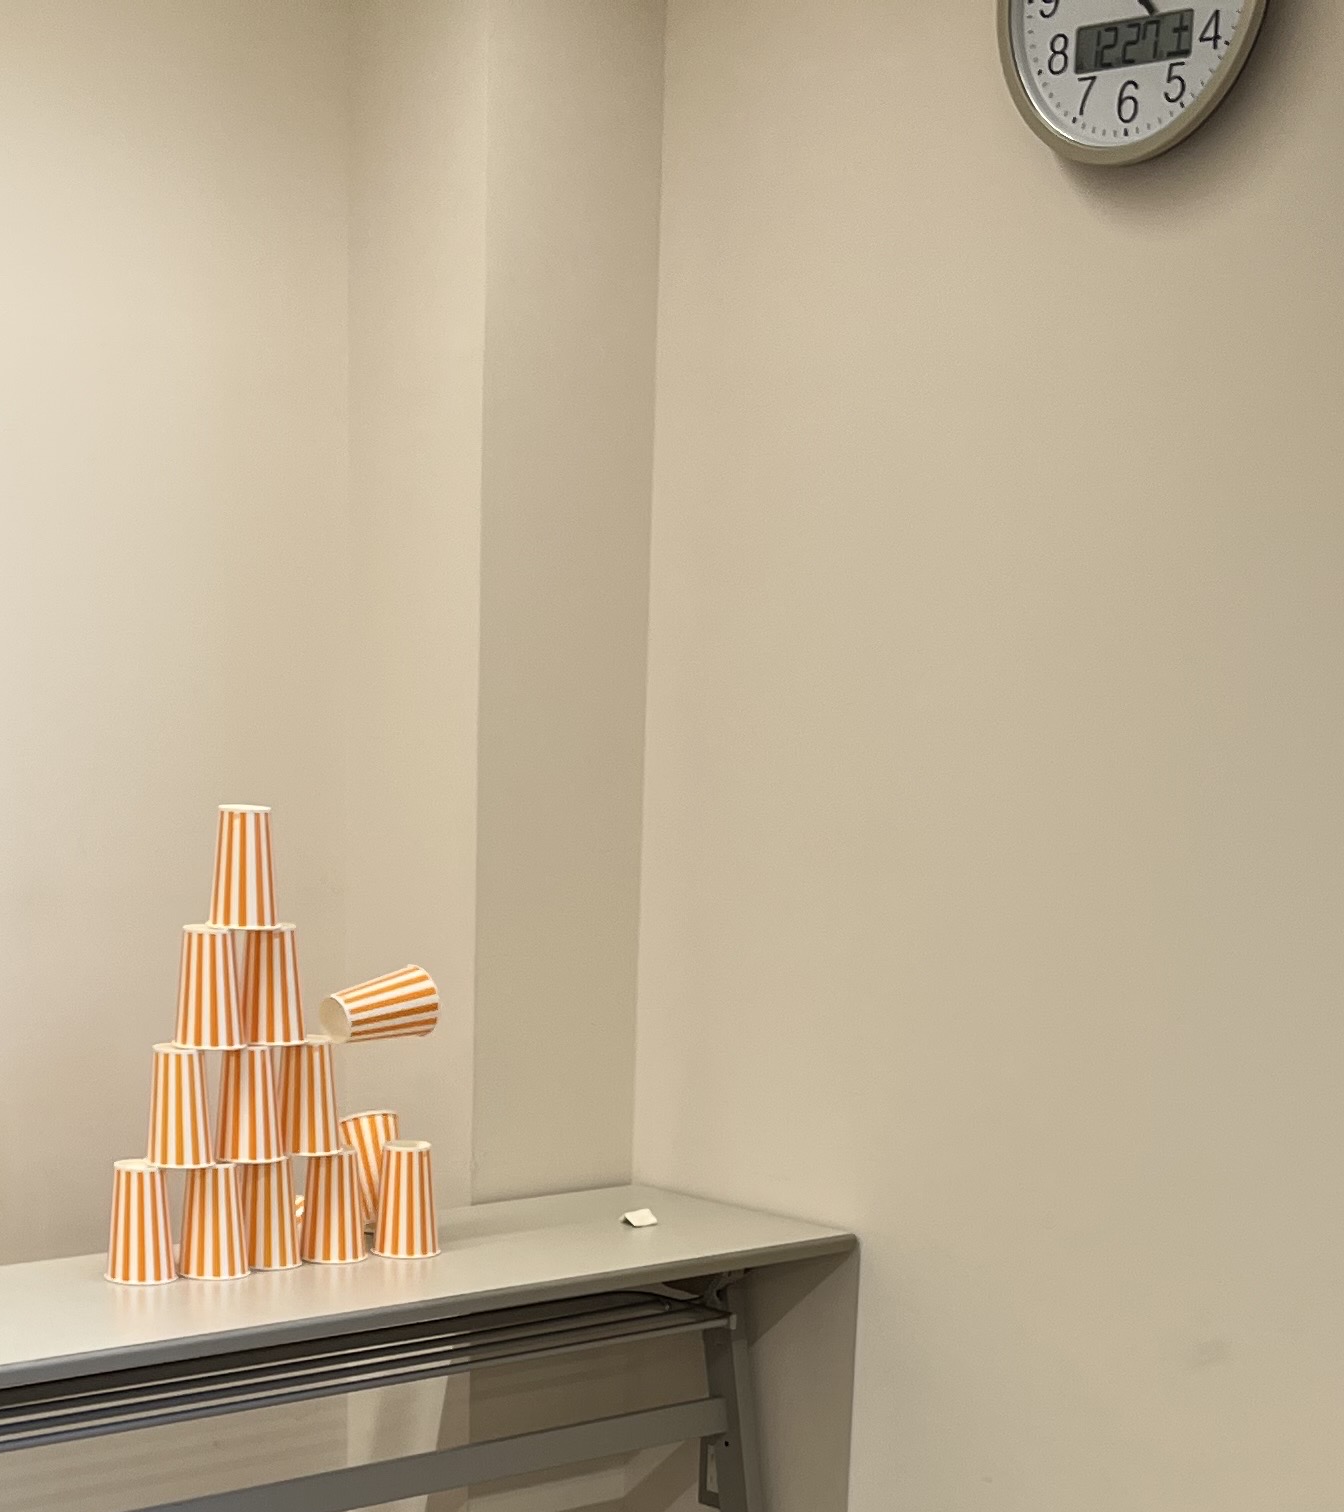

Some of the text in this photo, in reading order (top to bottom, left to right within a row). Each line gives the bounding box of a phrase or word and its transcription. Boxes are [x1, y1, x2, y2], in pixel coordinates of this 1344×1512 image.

[1198, 9, 1222, 50] 4
[1047, 33, 1070, 75] 8
[1077, 75, 1097, 116] 7
[1117, 80, 1139, 124] 6
[1163, 61, 1186, 103] 5
